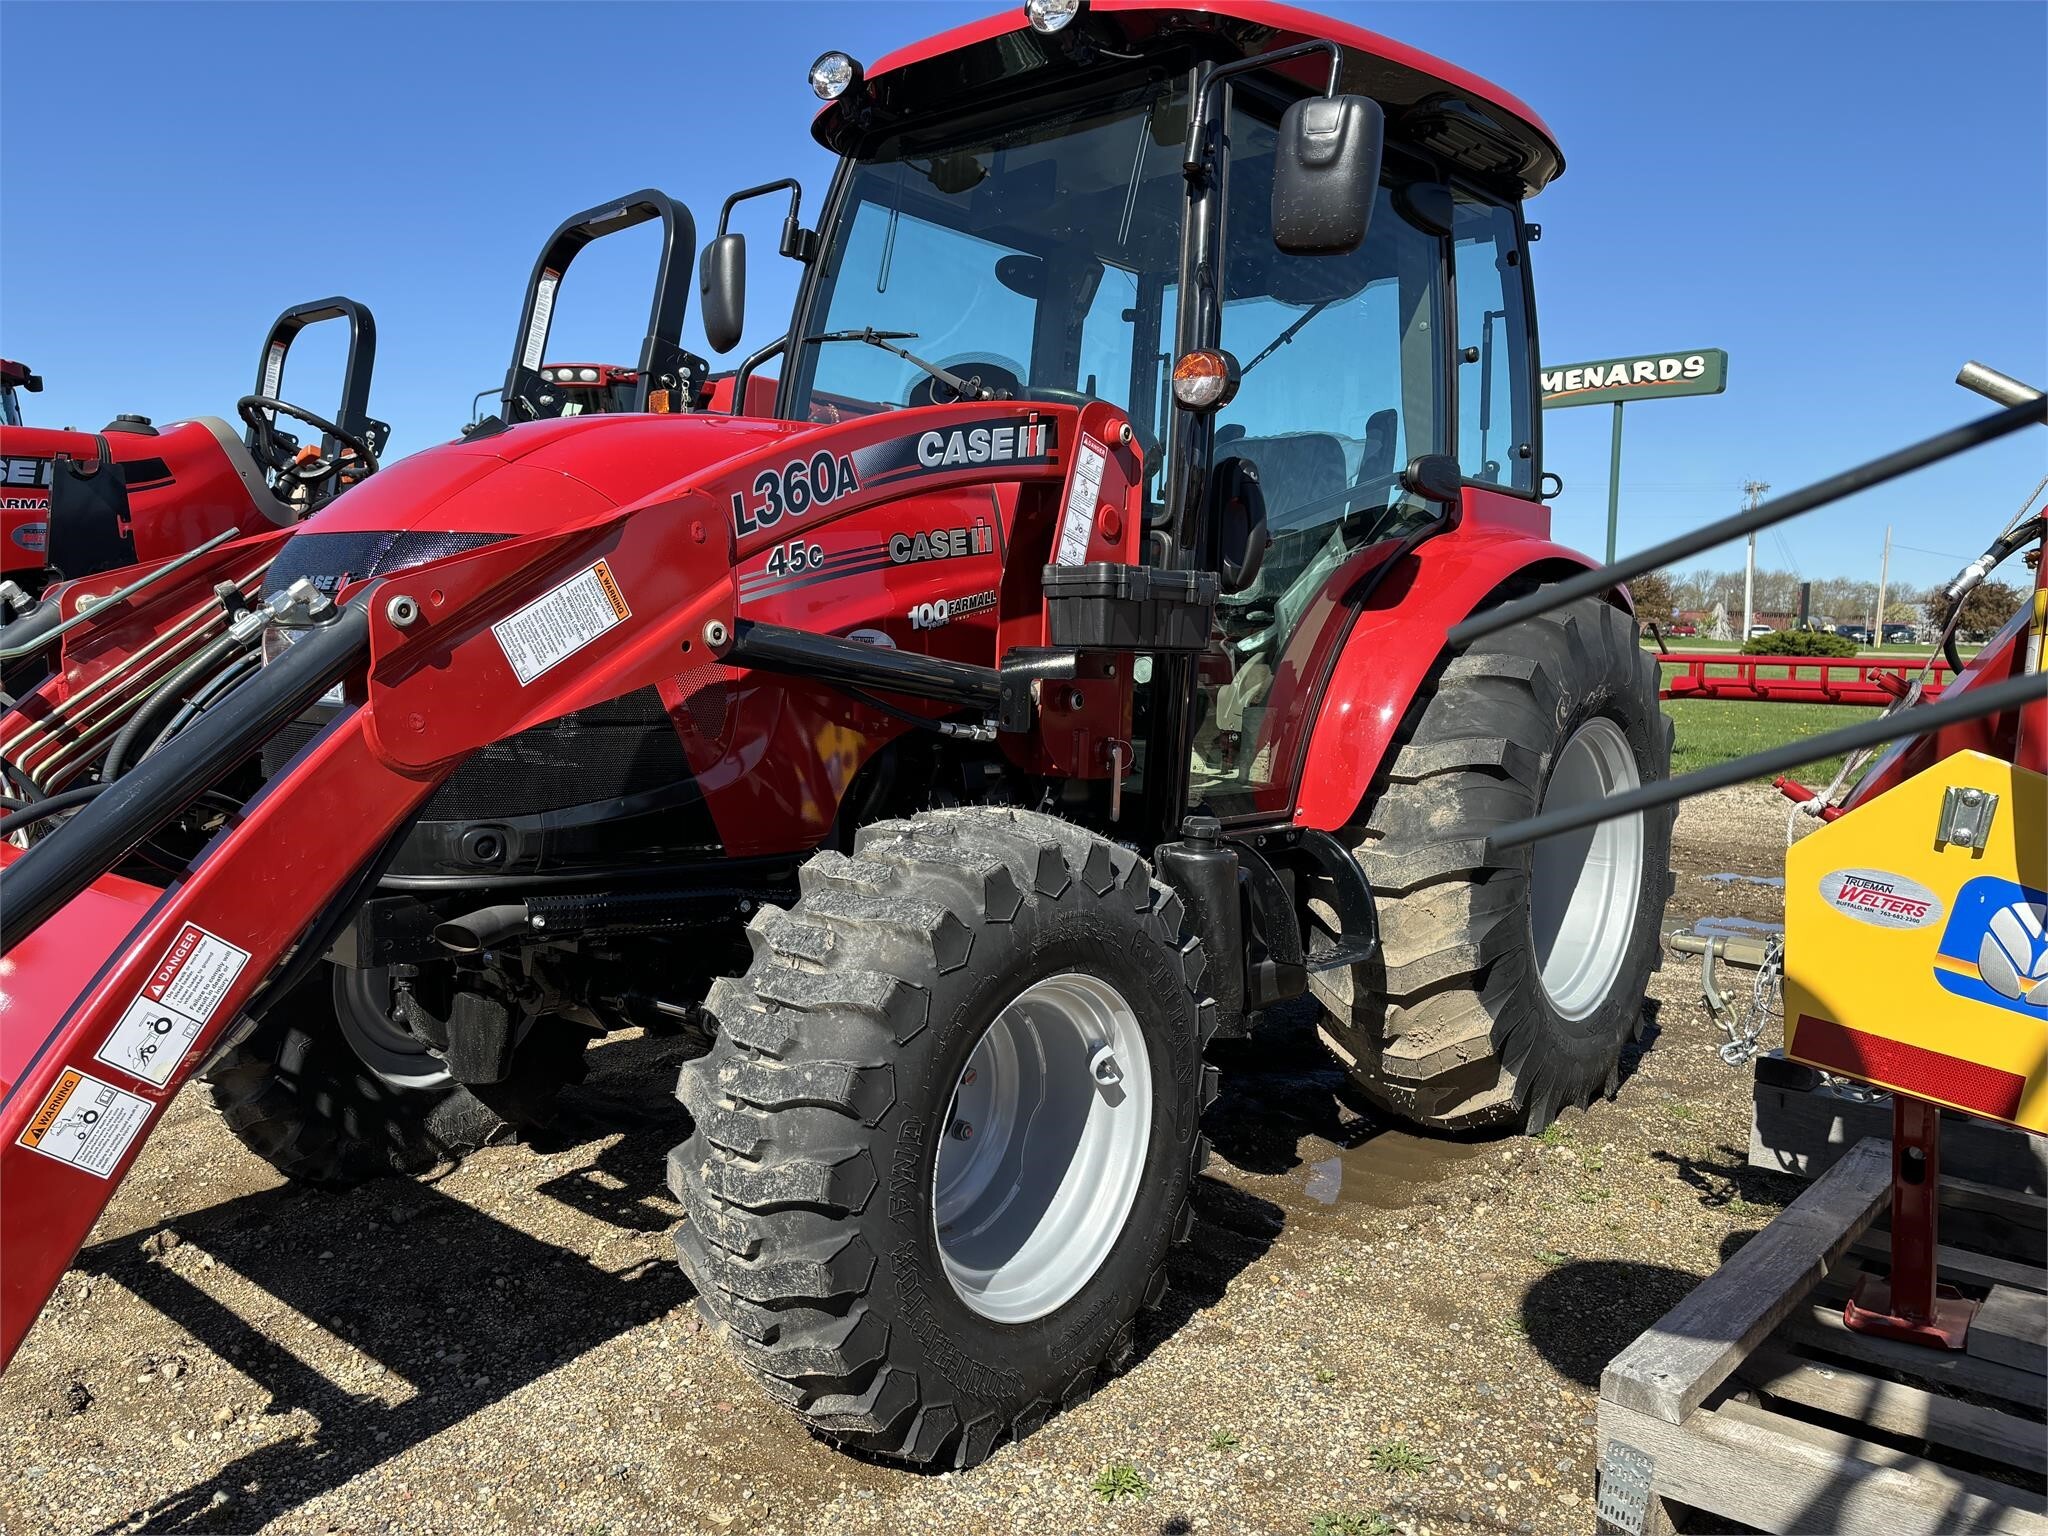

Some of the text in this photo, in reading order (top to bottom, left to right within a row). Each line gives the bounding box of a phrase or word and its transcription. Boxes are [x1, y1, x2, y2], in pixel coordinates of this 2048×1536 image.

[1541, 355, 1705, 392] MENARDS
[917, 426, 1014, 468] CASE
[731, 450, 860, 539] L360A
[889, 529, 967, 564] CASE
[602, 577, 624, 614] WARNING
[908, 599, 948, 630] 100
[948, 590, 997, 616] FARMALL
[1838, 884, 1932, 918] WELTERS
[1845, 875, 1894, 894] TRUEMAN
[157, 931, 197, 981] DANGER
[189, 989, 205, 1010] Failure
[202, 982, 210, 990] to
[207, 961, 224, 983] comply
[195, 995, 209, 1013] result
[210, 971, 225, 989] death
[200, 994, 217, 1015] serious
[37, 1078, 74, 1126] WARNING
